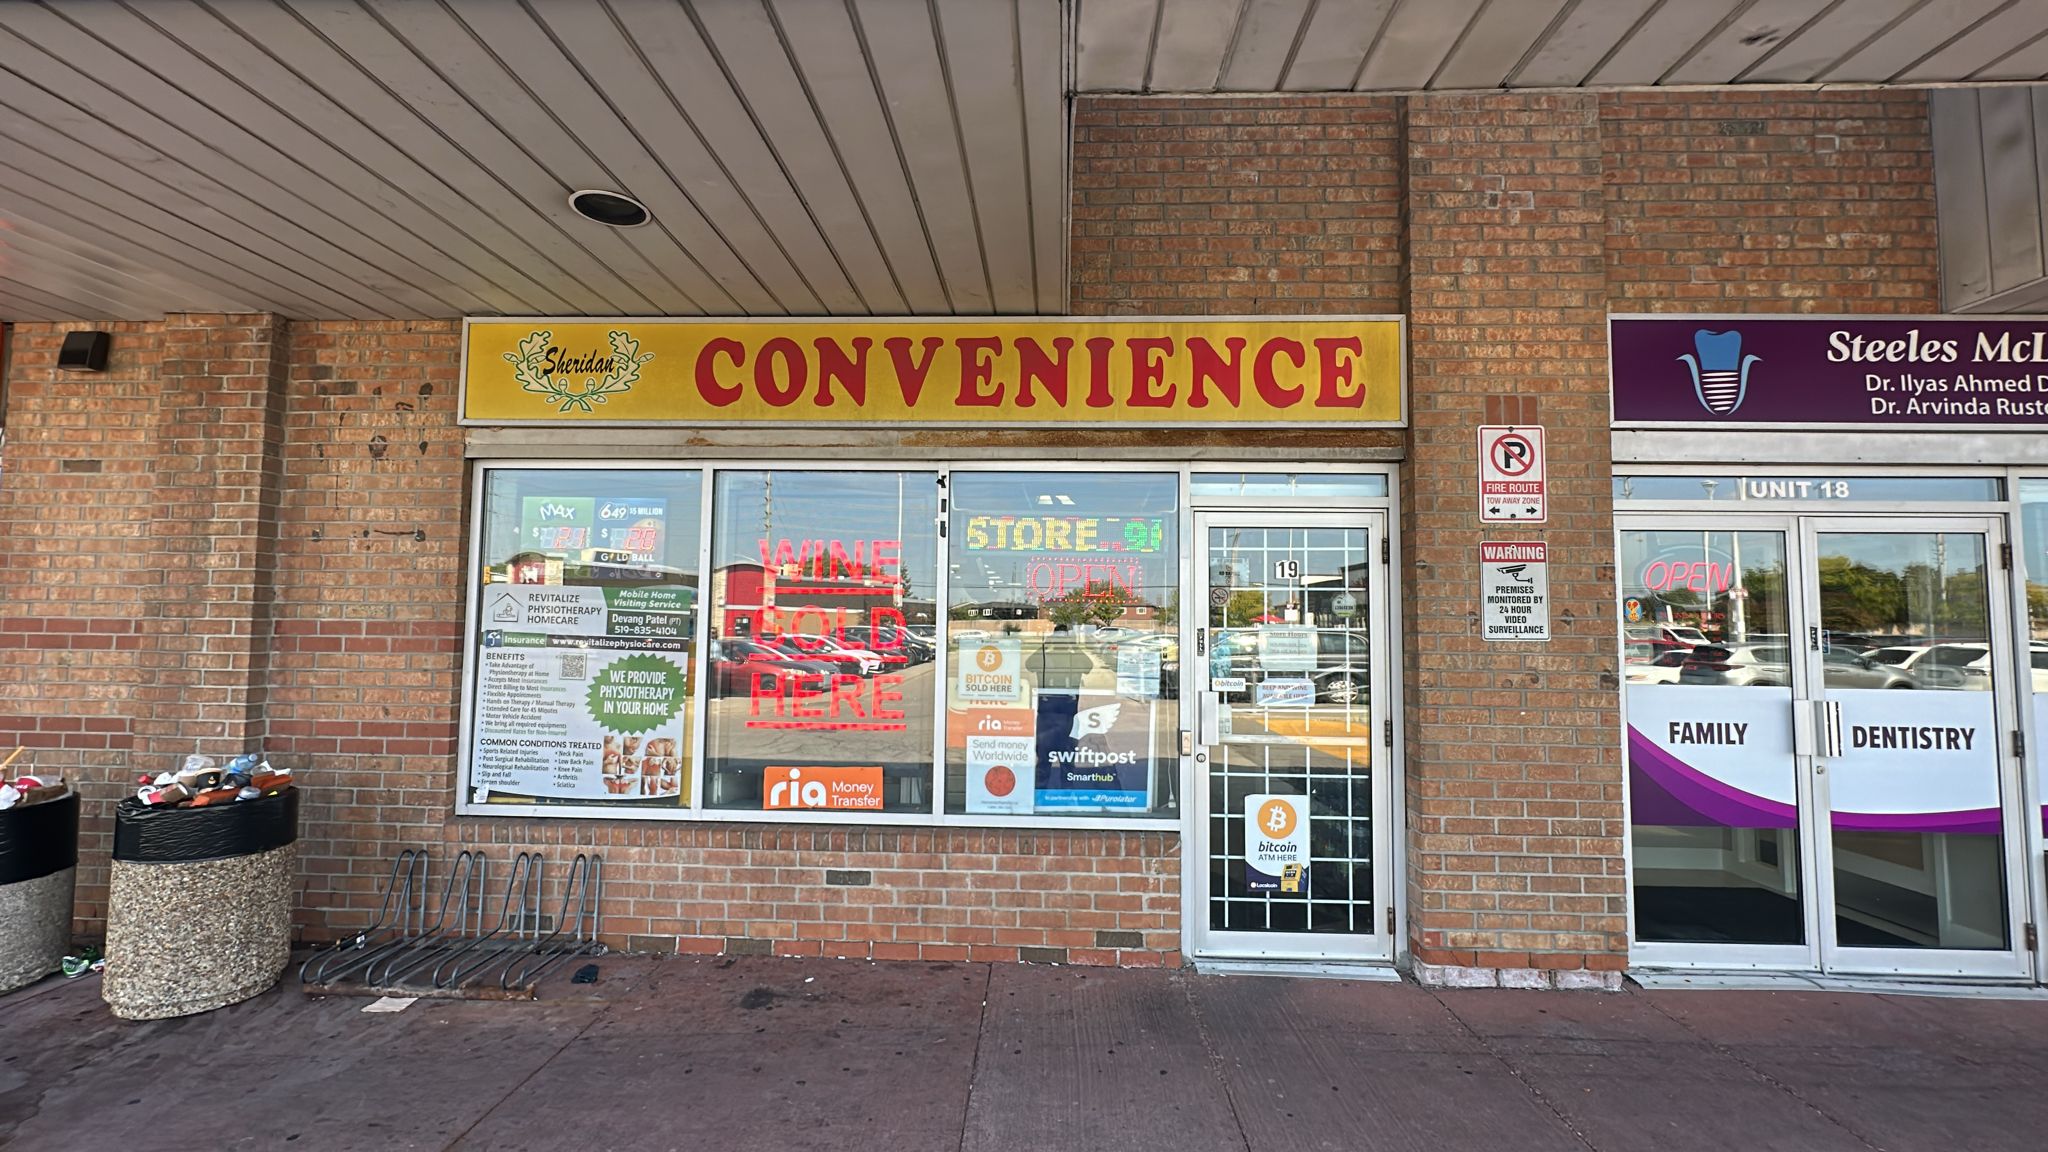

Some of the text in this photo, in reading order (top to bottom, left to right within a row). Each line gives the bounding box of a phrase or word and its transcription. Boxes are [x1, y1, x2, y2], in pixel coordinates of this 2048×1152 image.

[1827, 330, 1958, 363] Steeles
[542, 348, 615, 377] Sheridan
[695, 336, 1367, 409] CONVENIENCE
[1866, 374, 1895, 392] Dr.
[1900, 374, 1948, 396] Ilyas
[1954, 374, 2031, 393] Ahmed
[1871, 398, 1901, 415] Dr.
[1906, 398, 1990, 415] Arvinda
[1486, 483, 1540, 493] FIRE ROUTE
[1750, 481, 1850, 498] UNIT 18
[540, 503, 575, 520] MAX
[638, 508, 663, 516] MILLION
[632, 554, 655, 562] BALL
[1484, 546, 1545, 560] WARNING
[758, 539, 903, 583] WINE
[1278, 561, 1298, 578] 19
[1032, 563, 1137, 599] OPEN
[1645, 561, 1733, 593] OPEN
[619, 590, 677, 600] Mobile Home
[1496, 586, 1534, 594] PREMISES
[529, 594, 580, 603] REVITALIZE
[614, 599, 682, 609] Visiting Service
[1488, 596, 1543, 604] MONITORED BY
[528, 605, 602, 615] PHYSIOTHERAPY
[1500, 606, 1532, 614] 24 HOUR
[527, 616, 579, 625] HOMECARE
[612, 614, 682, 626] Devang Patel (PT)
[1504, 616, 1527, 624] VIDEO
[614, 625, 677, 635] 519-835-4104
[752, 605, 907, 651] SOLD
[1488, 626, 1544, 634] SURVEILLANCE
[504, 636, 545, 645] Insurance
[552, 637, 681, 650] www.revitalizephysiocare.com
[486, 653, 525, 661] BENEFITS
[610, 670, 667, 685] WE PROVIDE
[966, 674, 1013, 684] BITCOIN
[600, 686, 675, 700] PHYSIOTHERAPY
[966, 684, 1013, 693] SOLD HERE
[750, 672, 905, 719] HERE
[604, 701, 669, 716] IN YOUR HOME
[978, 714, 1002, 731] ria
[1669, 722, 1748, 746] FAMILY
[1852, 726, 1975, 751] DENTISTRY
[481, 738, 602, 750] COMMON CONDITIONS TREATED
[973, 740, 1028, 750] Send money
[495, 756, 514, 764] Surgical
[973, 750, 1029, 761] Worldwide
[1048, 747, 1136, 767] swiftpost
[482, 764, 513, 772] Neurological
[770, 768, 827, 806] ria
[832, 782, 874, 794] Money
[832, 795, 881, 806] Transfer
[1099, 795, 1137, 803] Purolator
[1258, 841, 1297, 853] bitcoin
